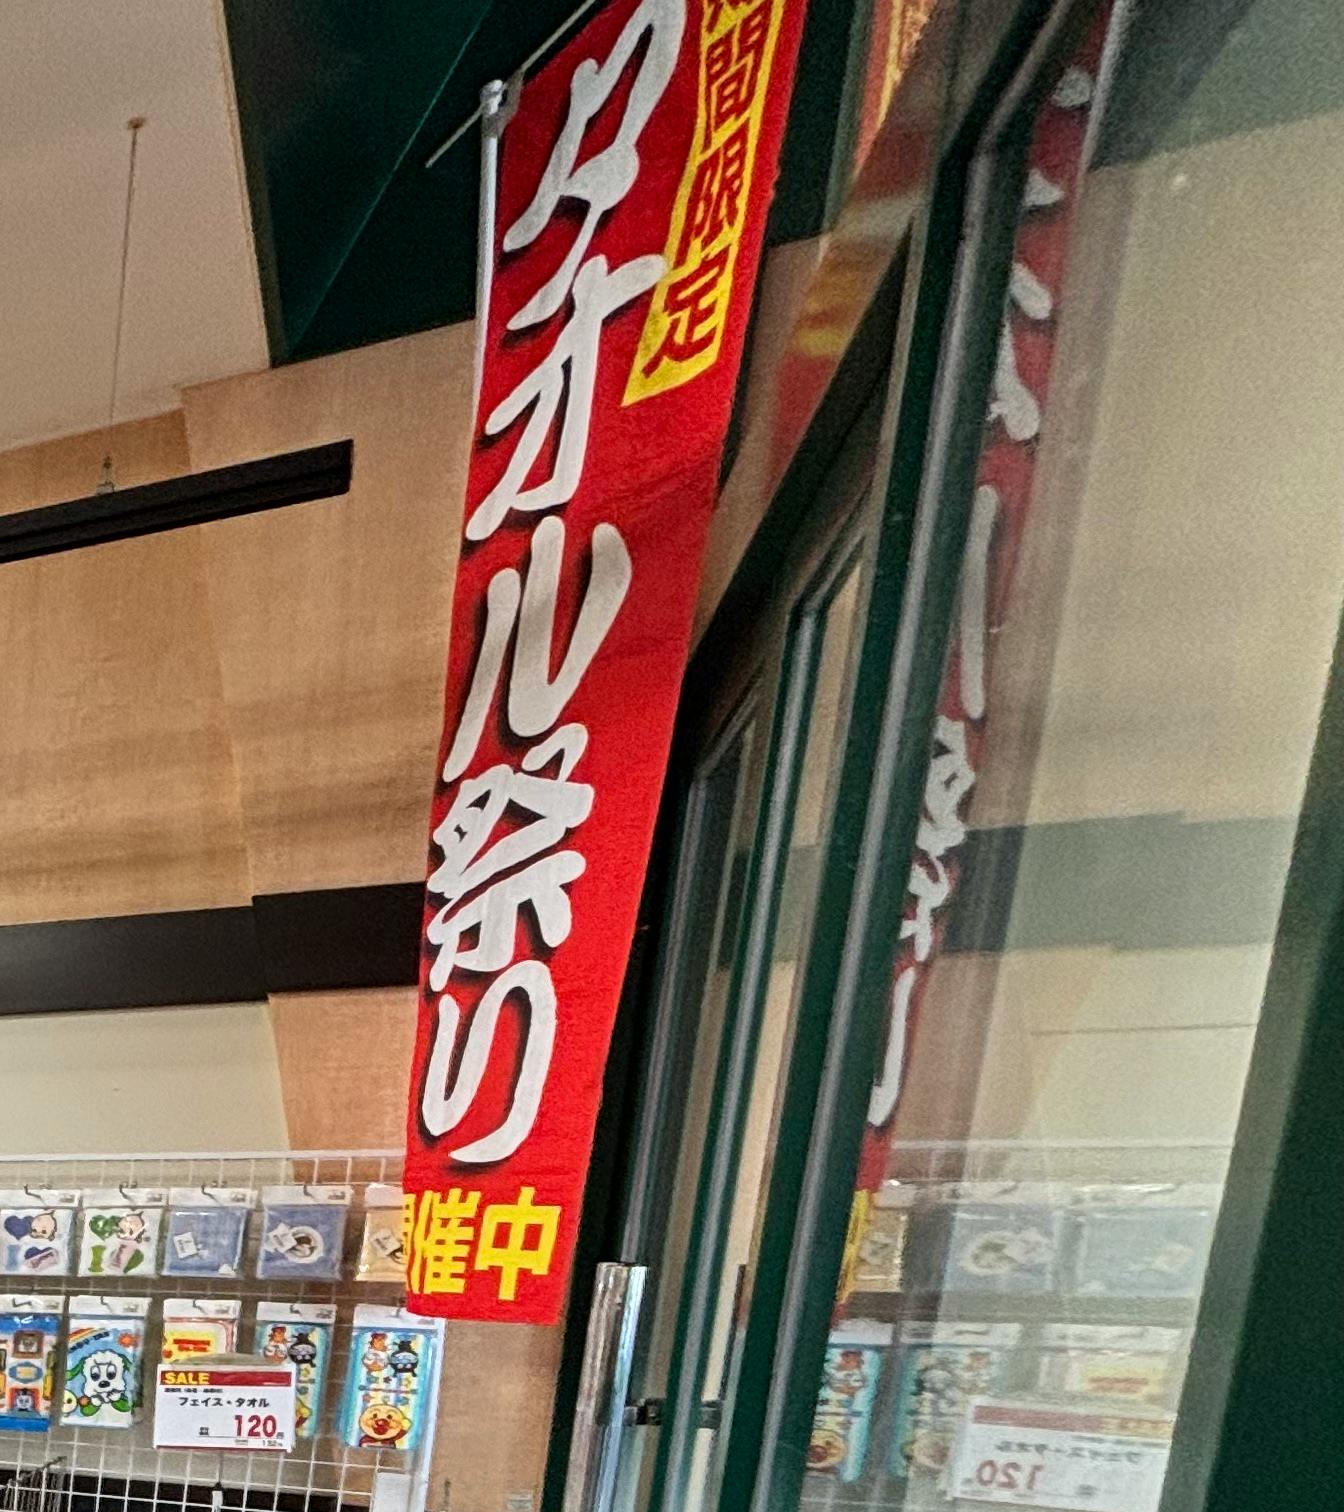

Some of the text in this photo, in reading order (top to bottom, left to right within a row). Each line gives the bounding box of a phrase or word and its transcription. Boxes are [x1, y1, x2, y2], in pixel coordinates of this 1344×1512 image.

[165, 1372, 210, 1385] SALE
[178, 1397, 270, 1408] フェイス・タオル
